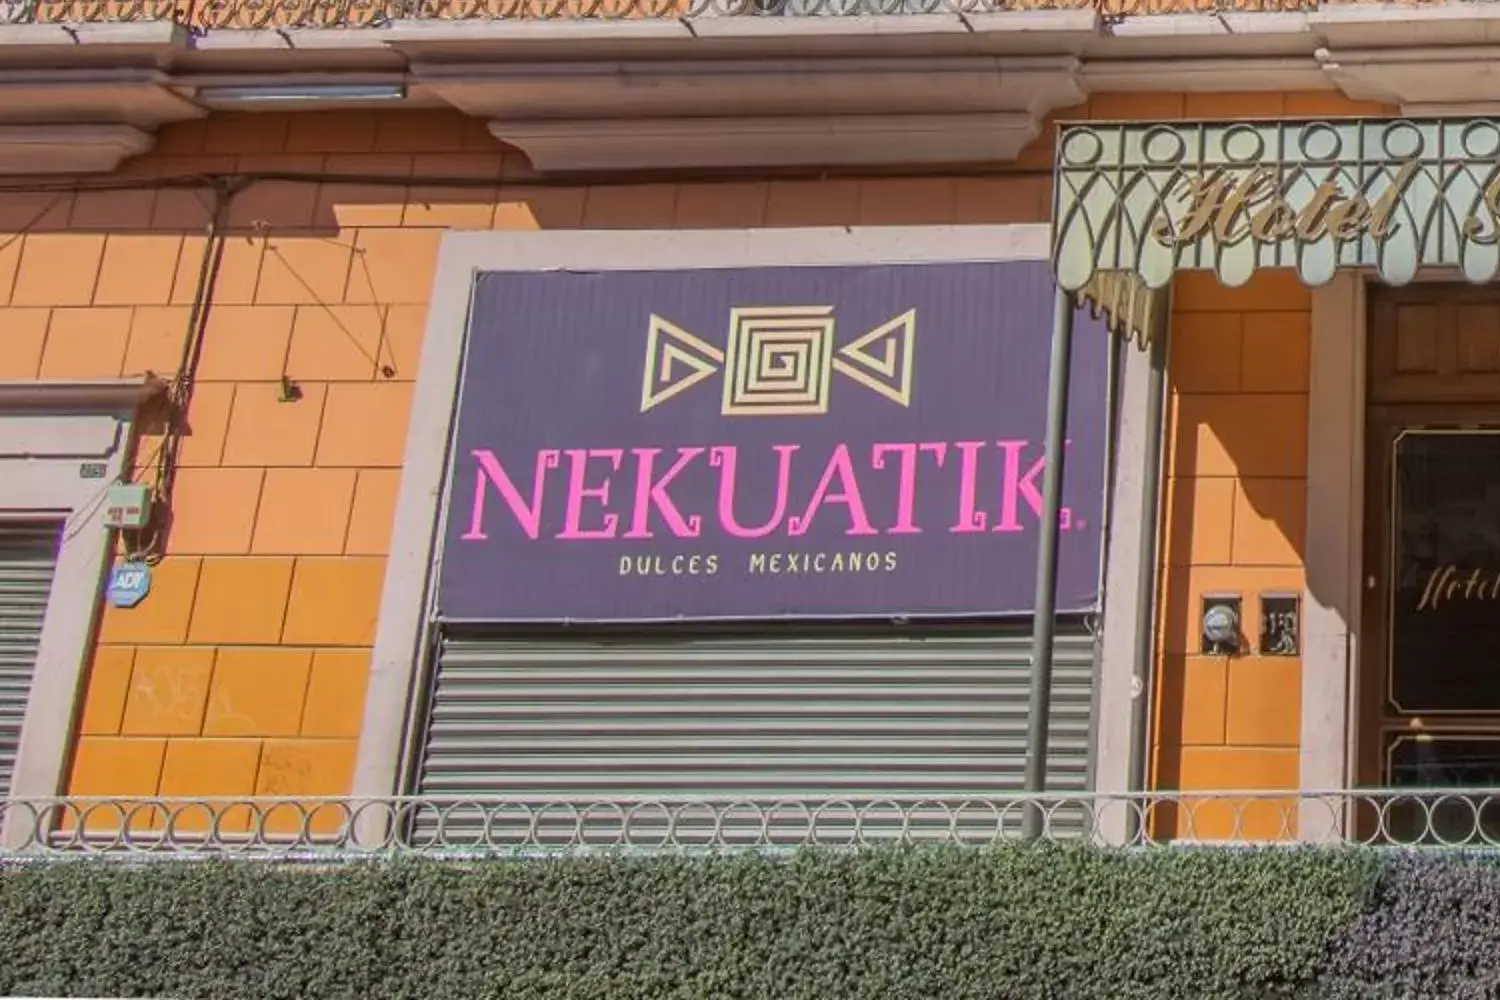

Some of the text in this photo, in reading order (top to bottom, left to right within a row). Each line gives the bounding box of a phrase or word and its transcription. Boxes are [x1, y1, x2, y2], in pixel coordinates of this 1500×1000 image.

[1151, 157, 1419, 246] Hotel
[460, 439, 1072, 540] NEKUATIK
[111, 570, 146, 590] ADT
[618, 551, 898, 576] DULCES MEXICANOS
